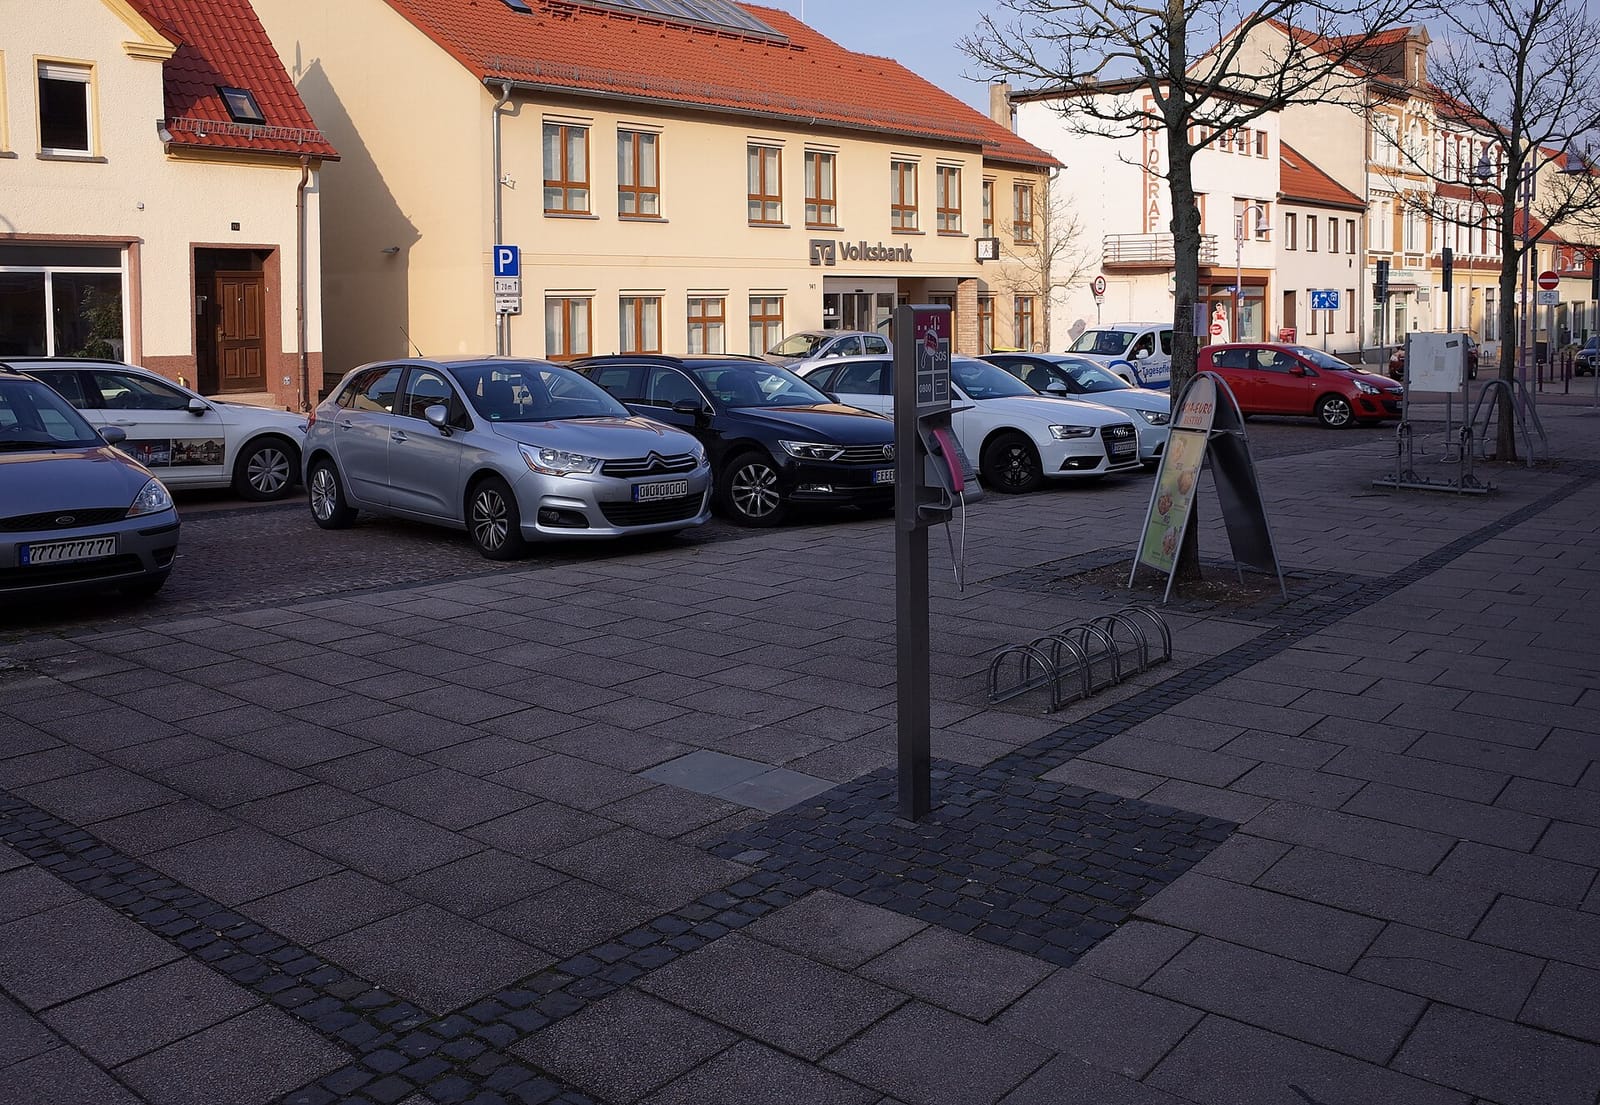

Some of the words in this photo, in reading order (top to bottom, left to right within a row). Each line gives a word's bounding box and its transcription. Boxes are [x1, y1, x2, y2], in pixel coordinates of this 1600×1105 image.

[839, 240, 913, 262] Volksbank
[499, 249, 513, 273] P
[934, 351, 947, 362] SOS
[919, 383, 932, 393] 0800
